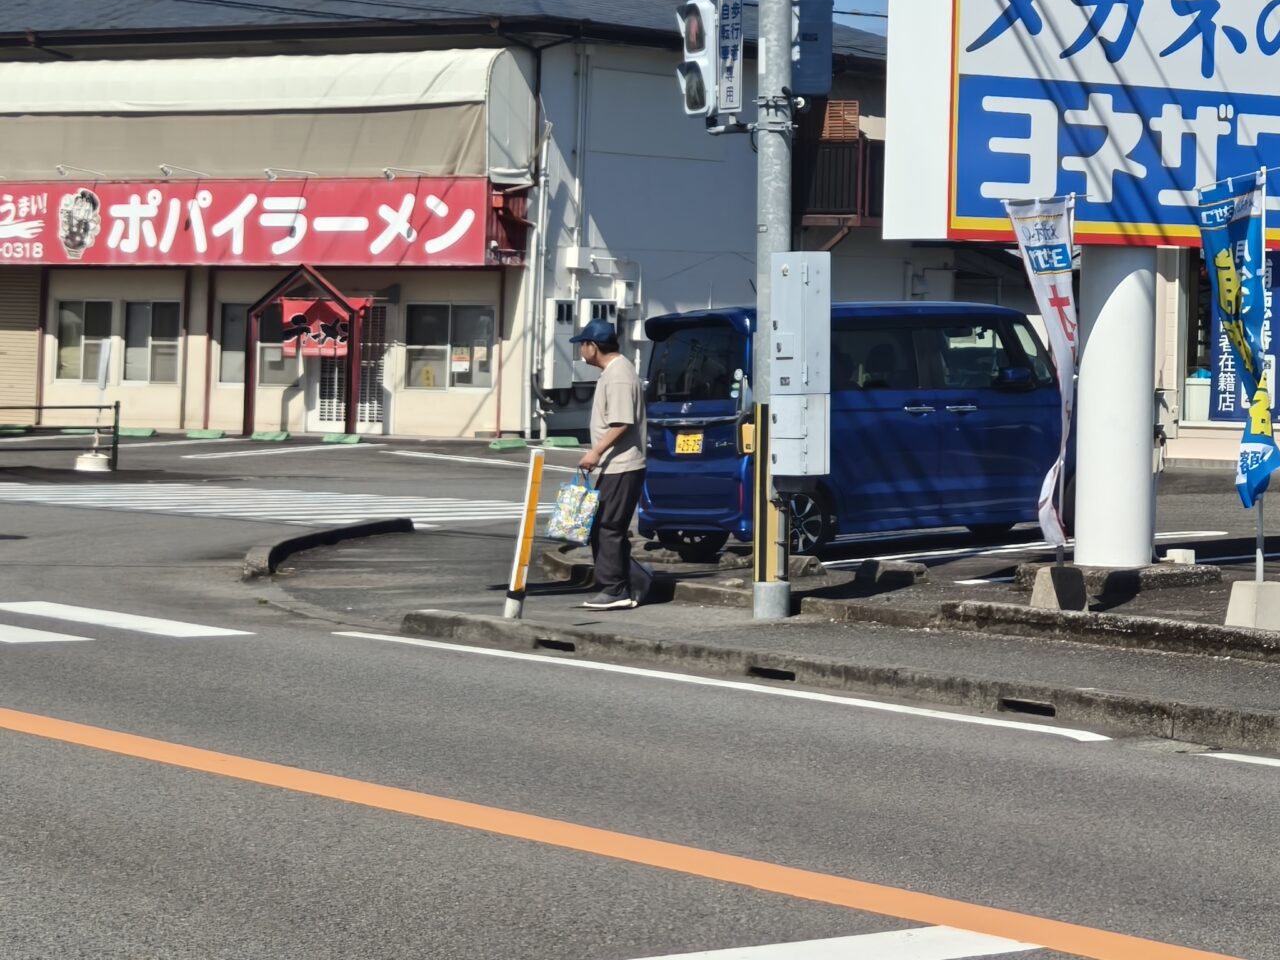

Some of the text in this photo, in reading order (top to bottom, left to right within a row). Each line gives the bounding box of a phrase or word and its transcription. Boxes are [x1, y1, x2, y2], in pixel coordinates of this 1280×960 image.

[107, 188, 476, 256] ポパイラーメン
[1218, 317, 1236, 412] 者在籍店
